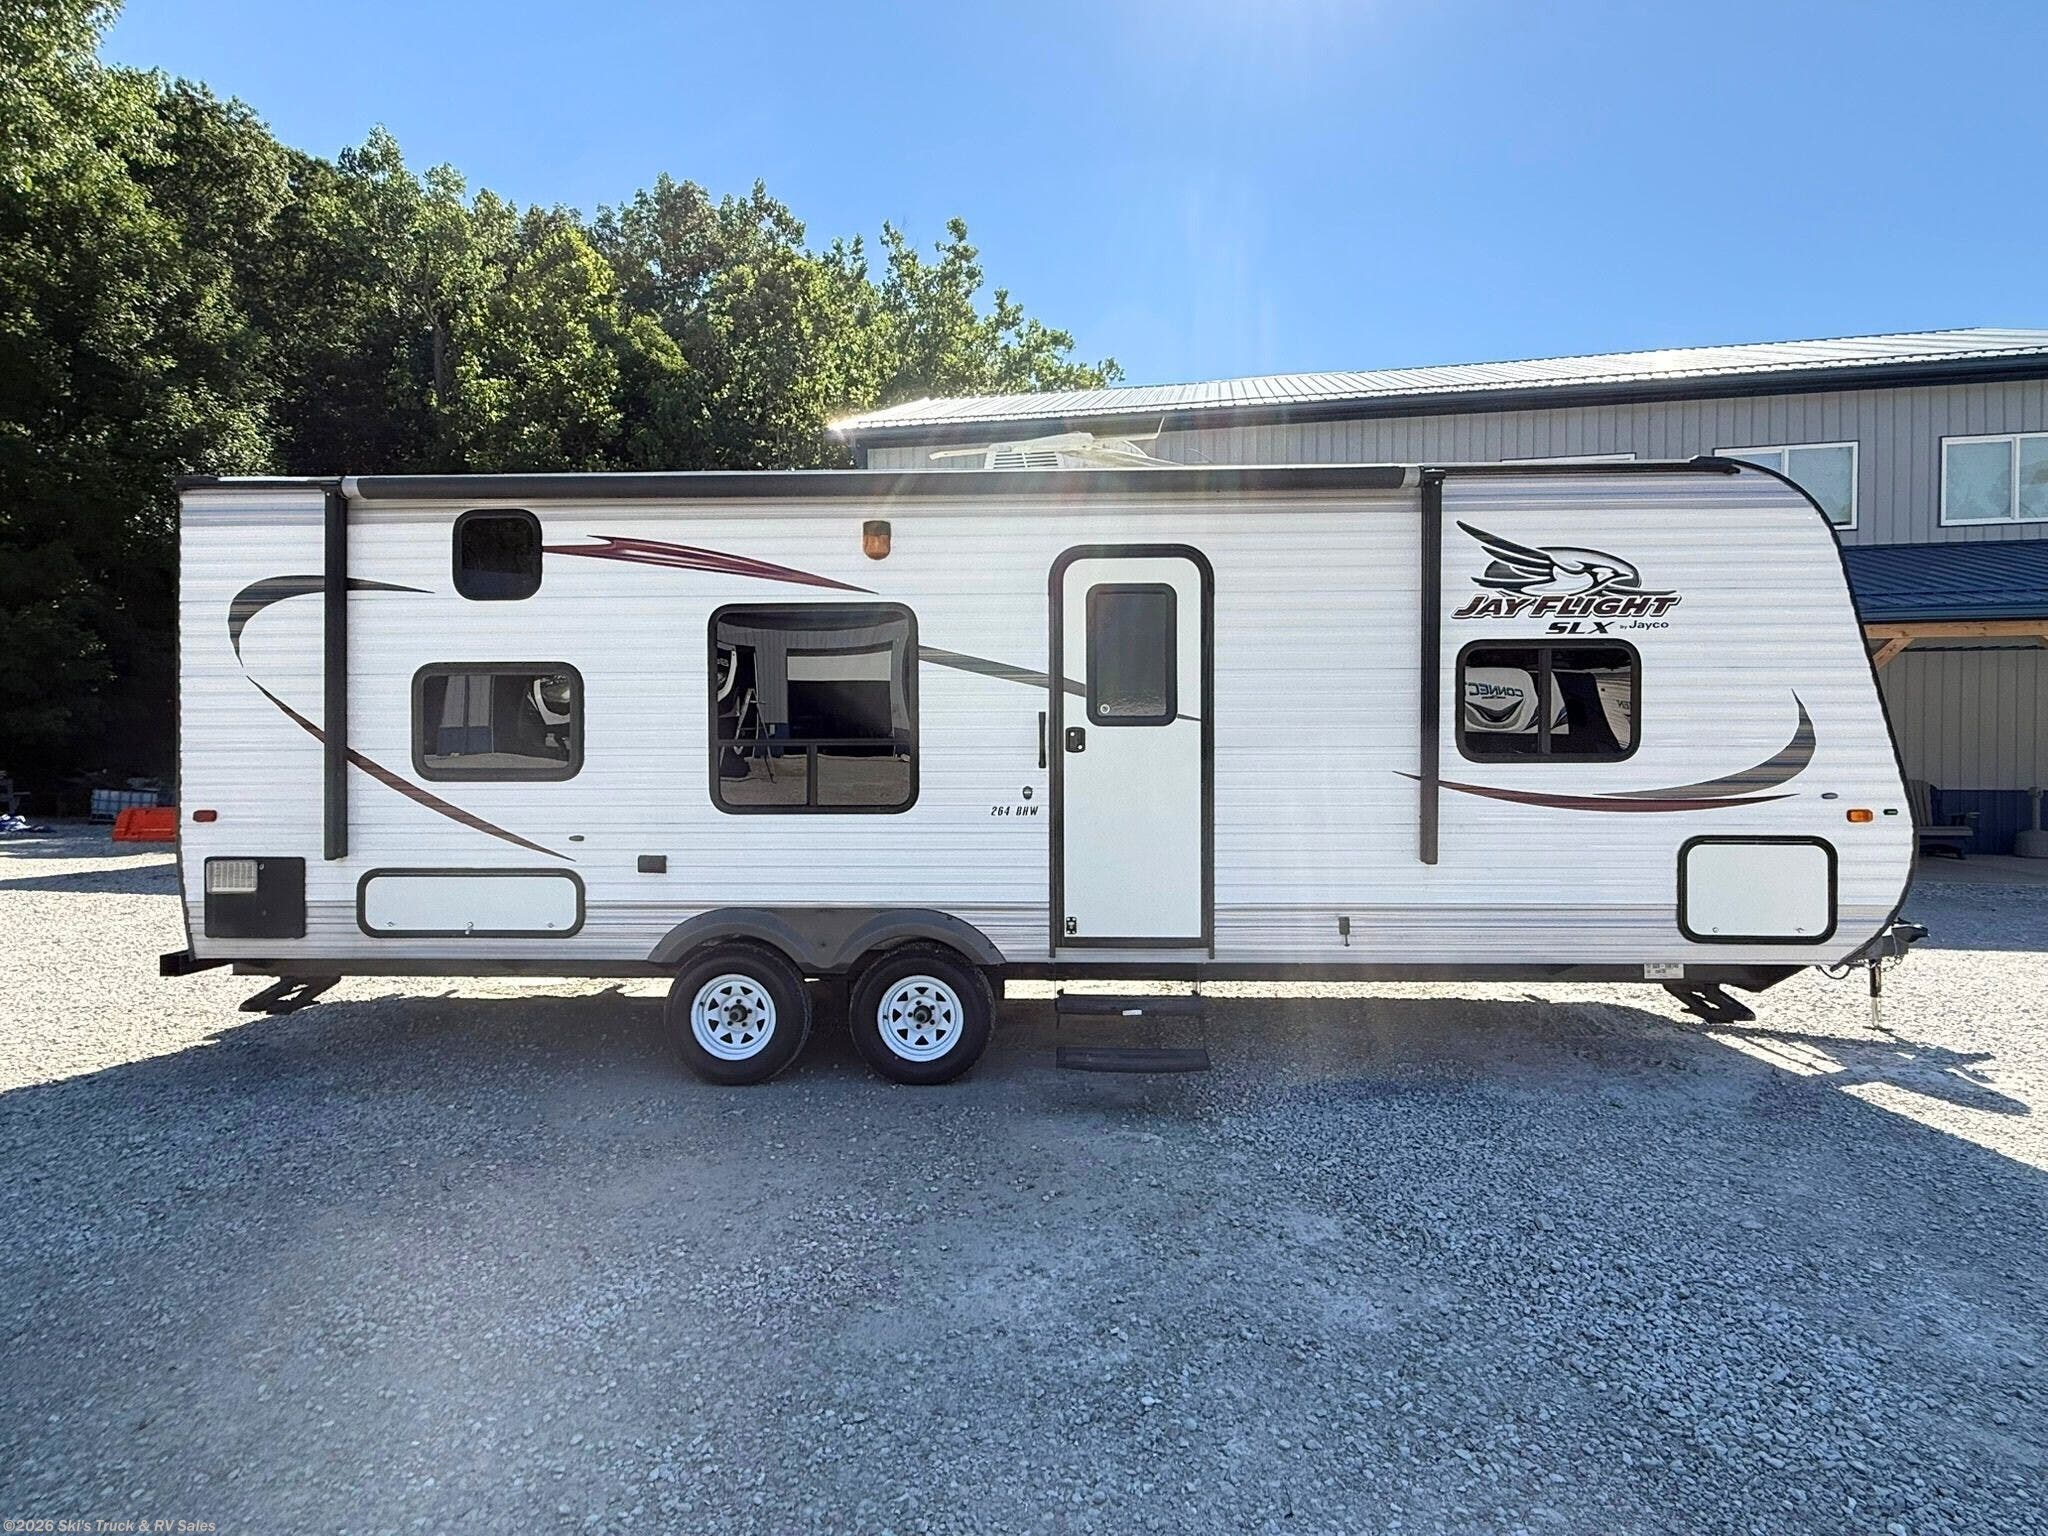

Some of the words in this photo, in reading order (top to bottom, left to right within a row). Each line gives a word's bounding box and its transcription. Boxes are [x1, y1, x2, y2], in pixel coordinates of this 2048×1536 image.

[1545, 621, 1615, 635] SLX
[1629, 620, 1669, 630] Jayco
[991, 806, 1011, 816] 264
[1015, 806, 1039, 816] BHW
